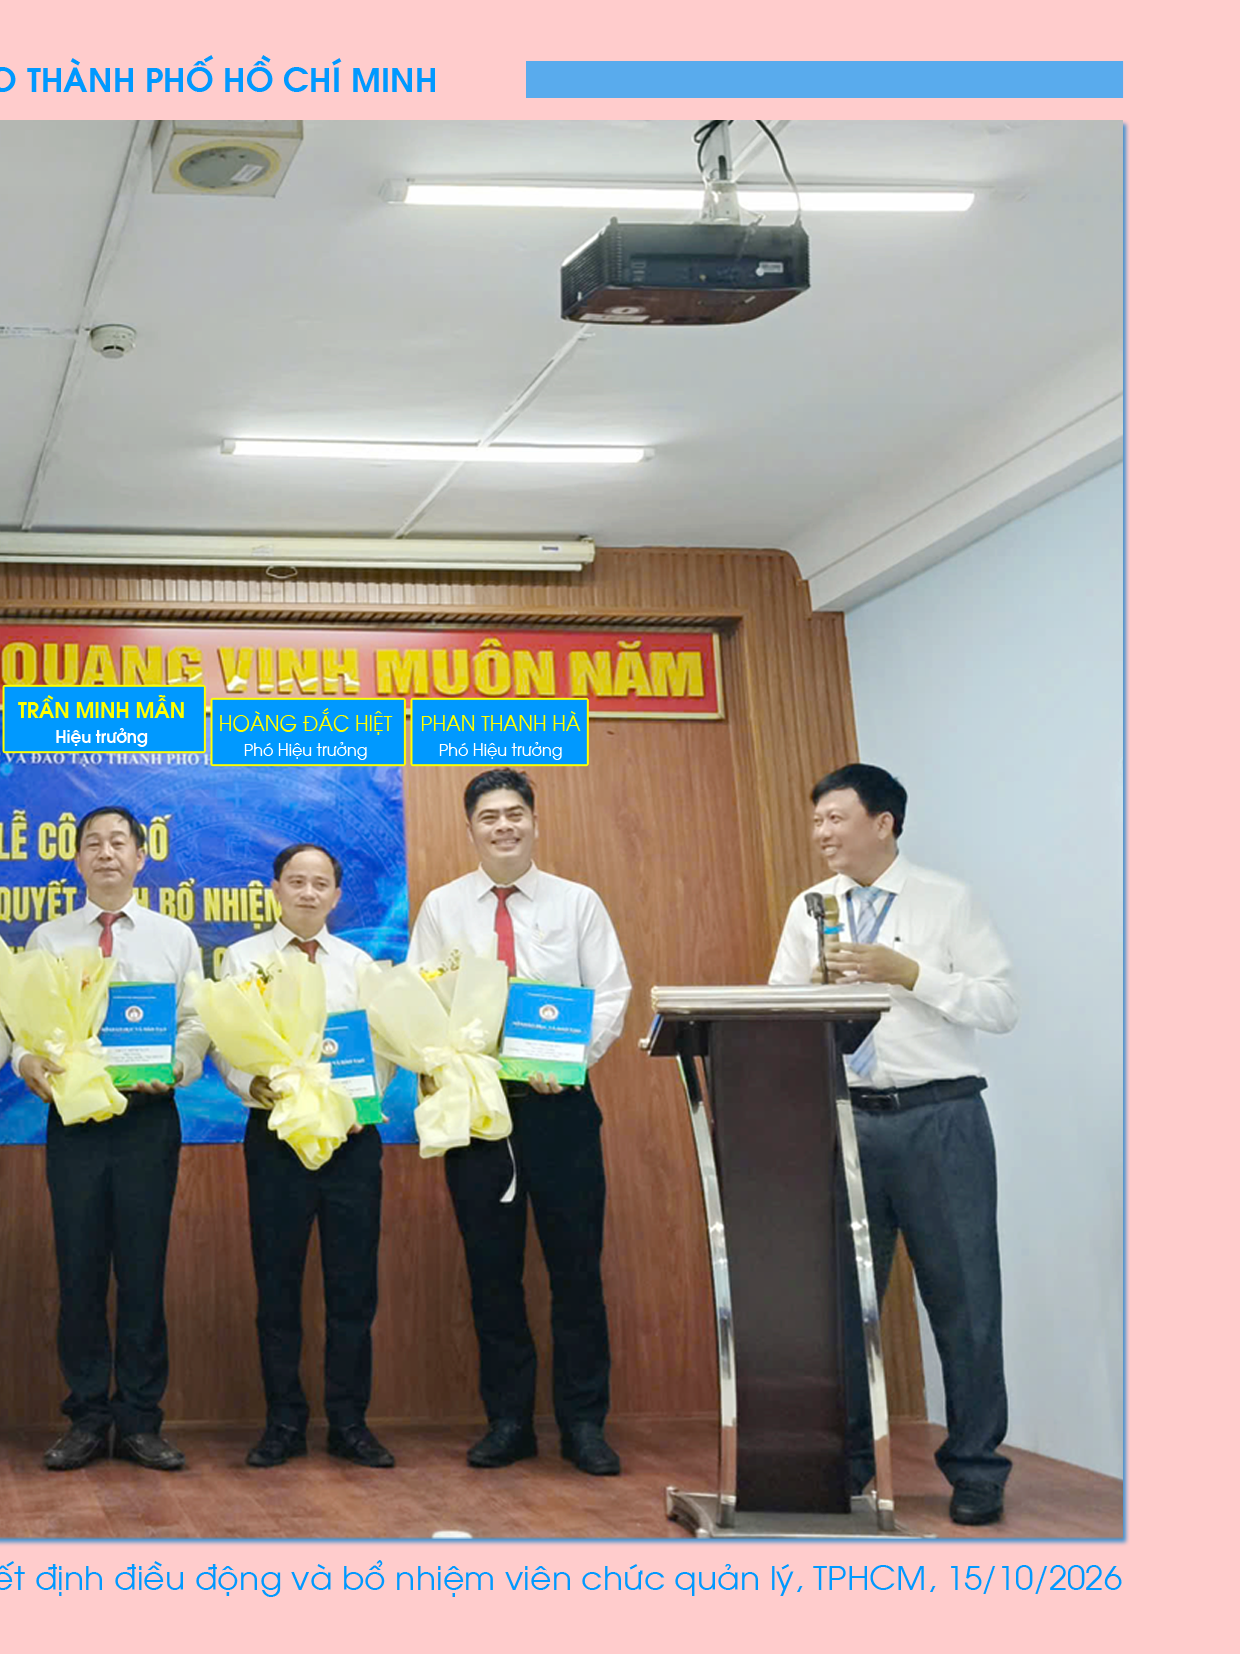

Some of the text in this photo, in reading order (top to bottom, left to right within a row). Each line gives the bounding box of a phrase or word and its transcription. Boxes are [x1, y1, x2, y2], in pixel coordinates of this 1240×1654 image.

[0, 641, 204, 686] QUANG
[218, 647, 360, 694] VINH
[375, 637, 556, 696] MUÔN
[569, 640, 704, 697] NĂM
[38, 812, 77, 860] CÔ
[141, 814, 172, 861] Ố
[159, 877, 194, 921] BỔ
